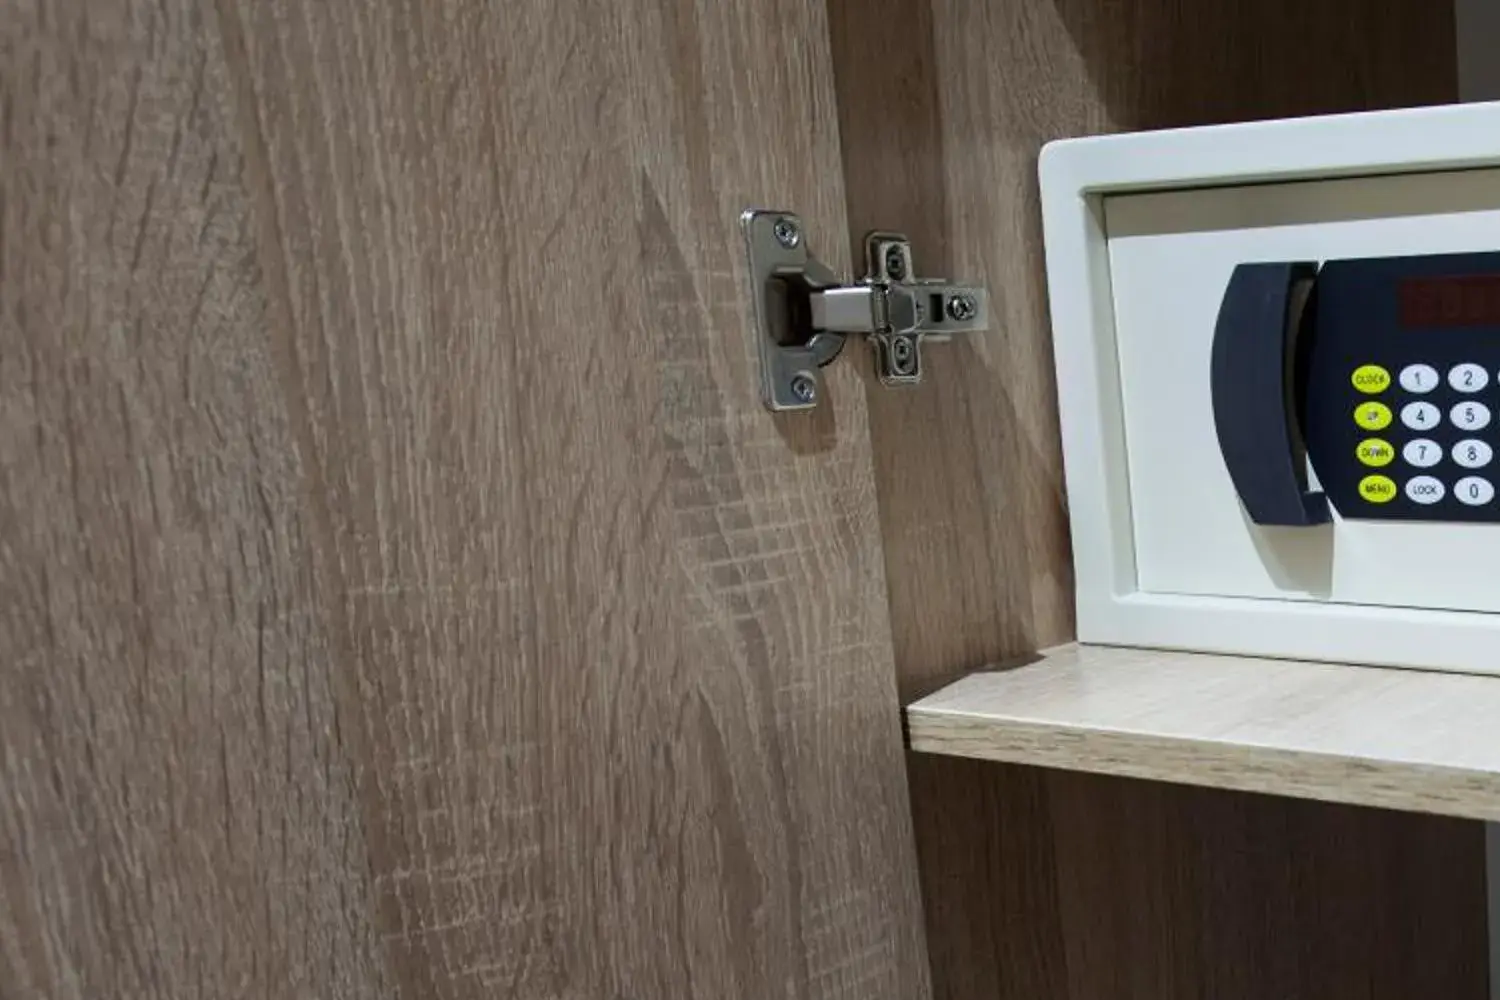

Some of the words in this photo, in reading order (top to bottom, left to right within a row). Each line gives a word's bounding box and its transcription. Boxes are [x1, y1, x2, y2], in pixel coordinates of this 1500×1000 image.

[1414, 372, 1421, 386] 1
[1463, 371, 1473, 386] 2
[1415, 409, 1425, 423] 4
[1465, 408, 1475, 423] 5
[1361, 447, 1389, 457] DOWN
[1418, 446, 1427, 460] 7
[1467, 446, 1476, 461] 8
[1412, 484, 1437, 495] LOCK
[1469, 484, 1479, 499] 0
